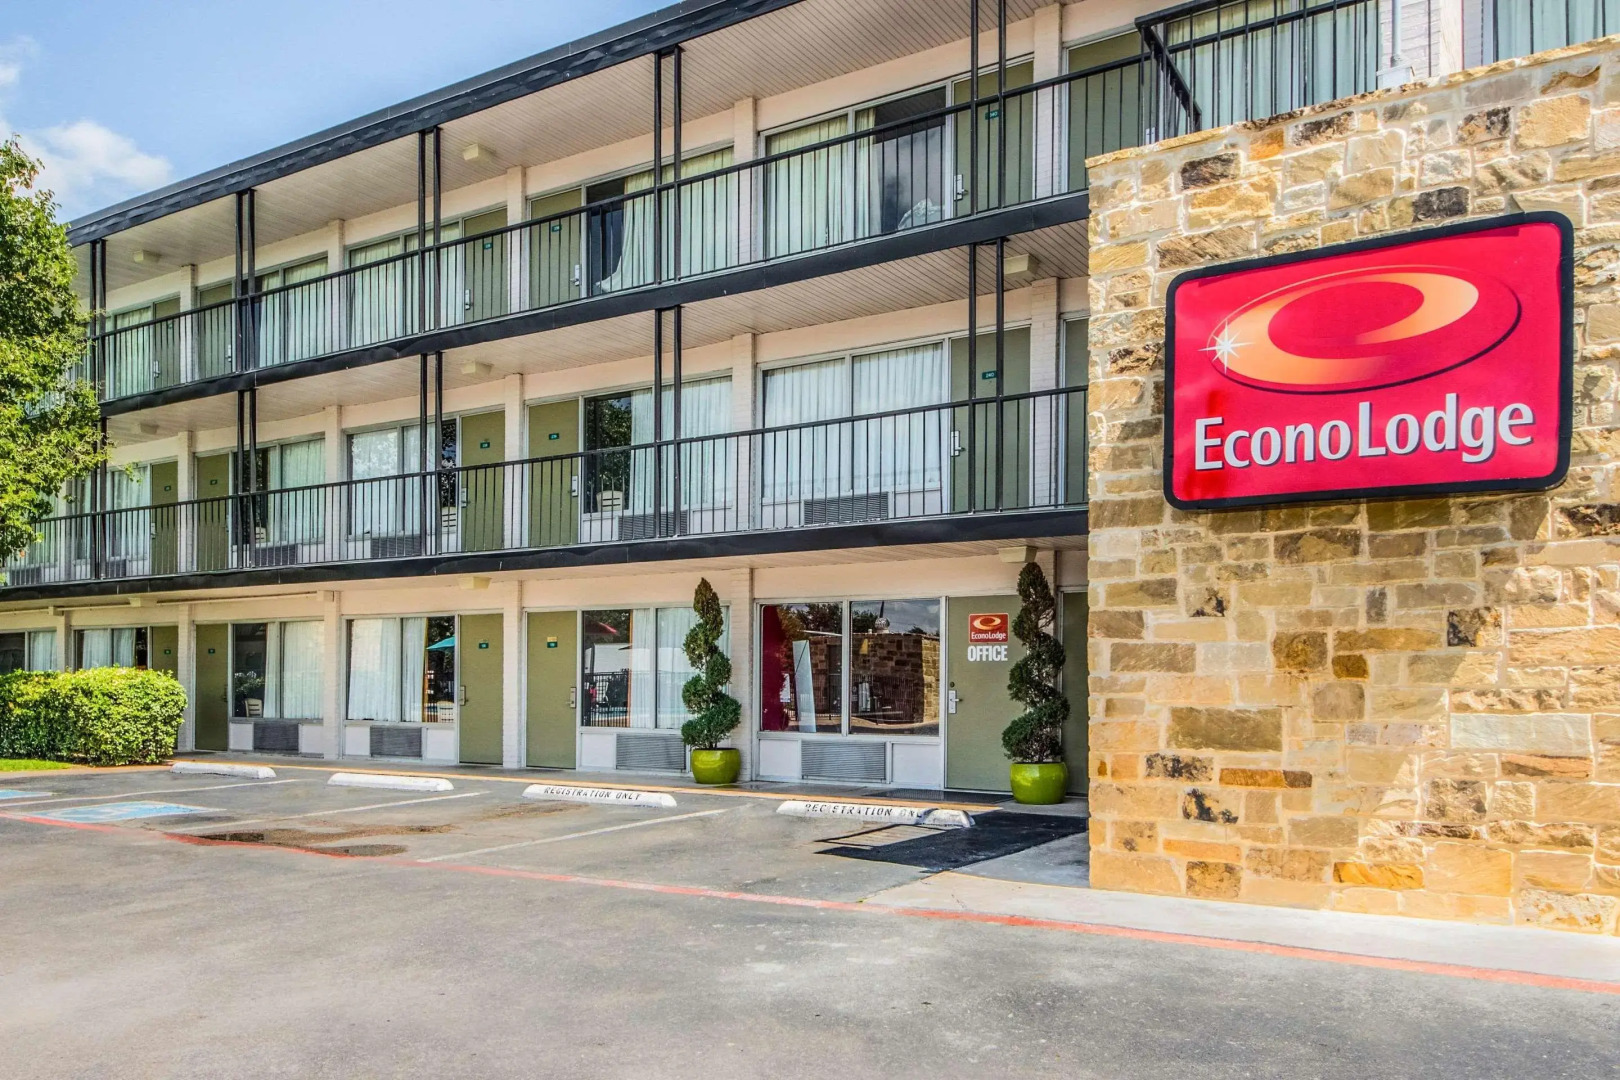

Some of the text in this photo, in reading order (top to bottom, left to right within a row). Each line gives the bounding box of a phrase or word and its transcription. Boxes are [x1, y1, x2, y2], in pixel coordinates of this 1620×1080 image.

[1194, 392, 1535, 471] EconoLodge
[971, 631, 1007, 641] EconoLodge
[967, 645, 1009, 662] OFFICE
[544, 786, 642, 800] REGISTRATION ONLY
[805, 803, 893, 816] REGSTRATION
